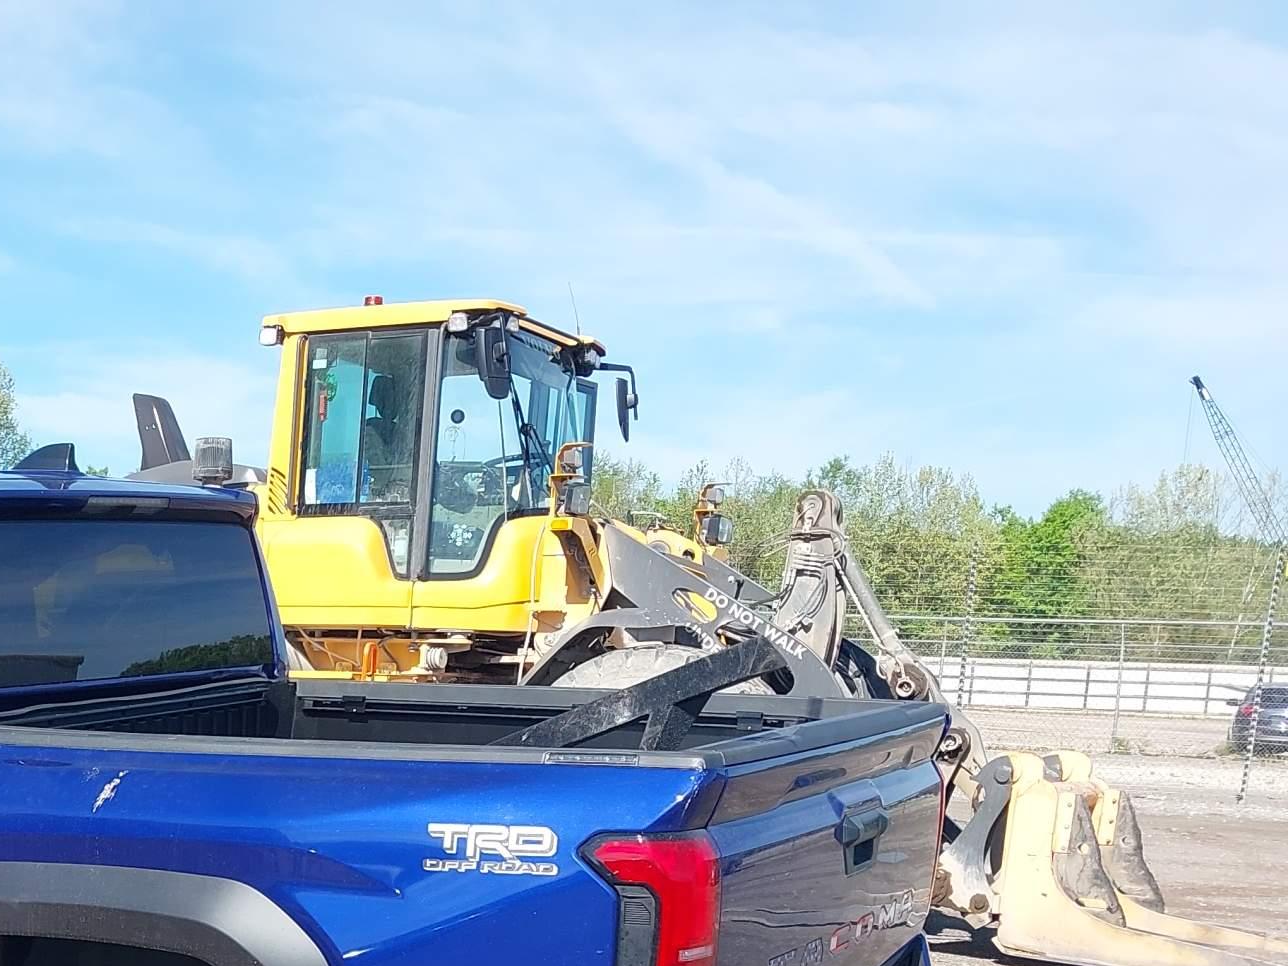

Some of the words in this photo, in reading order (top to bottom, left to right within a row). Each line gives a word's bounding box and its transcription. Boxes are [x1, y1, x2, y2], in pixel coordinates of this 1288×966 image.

[704, 588, 729, 608] DO
[728, 604, 764, 630] NOT
[764, 624, 808, 660] WALK
[428, 823, 558, 862] TRD
[423, 859, 477, 873] OFF
[480, 861, 558, 876] ROAD
